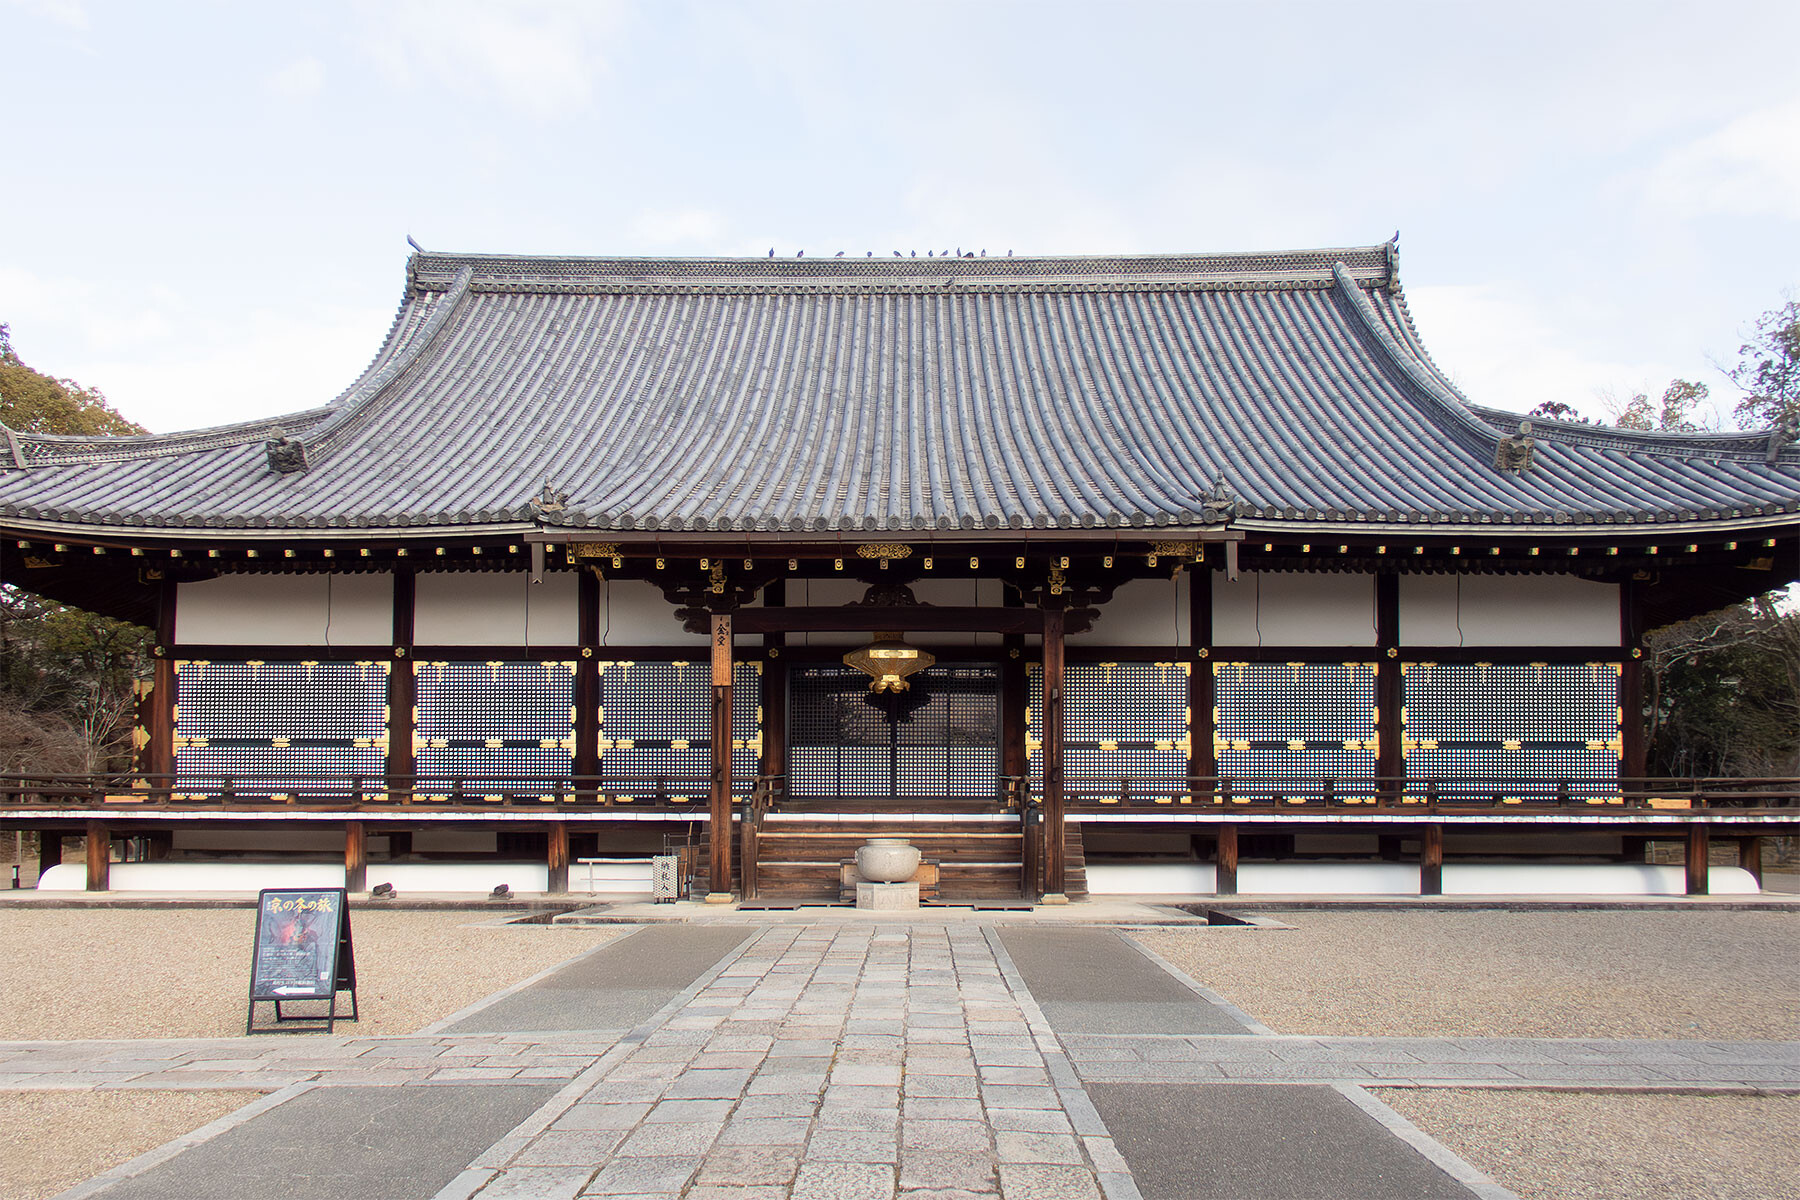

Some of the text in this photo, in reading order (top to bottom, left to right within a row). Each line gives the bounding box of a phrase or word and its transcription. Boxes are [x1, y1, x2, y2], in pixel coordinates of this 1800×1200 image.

[716, 623, 728, 646] 金堂
[271, 897, 333, 915] 京の冬の旅
